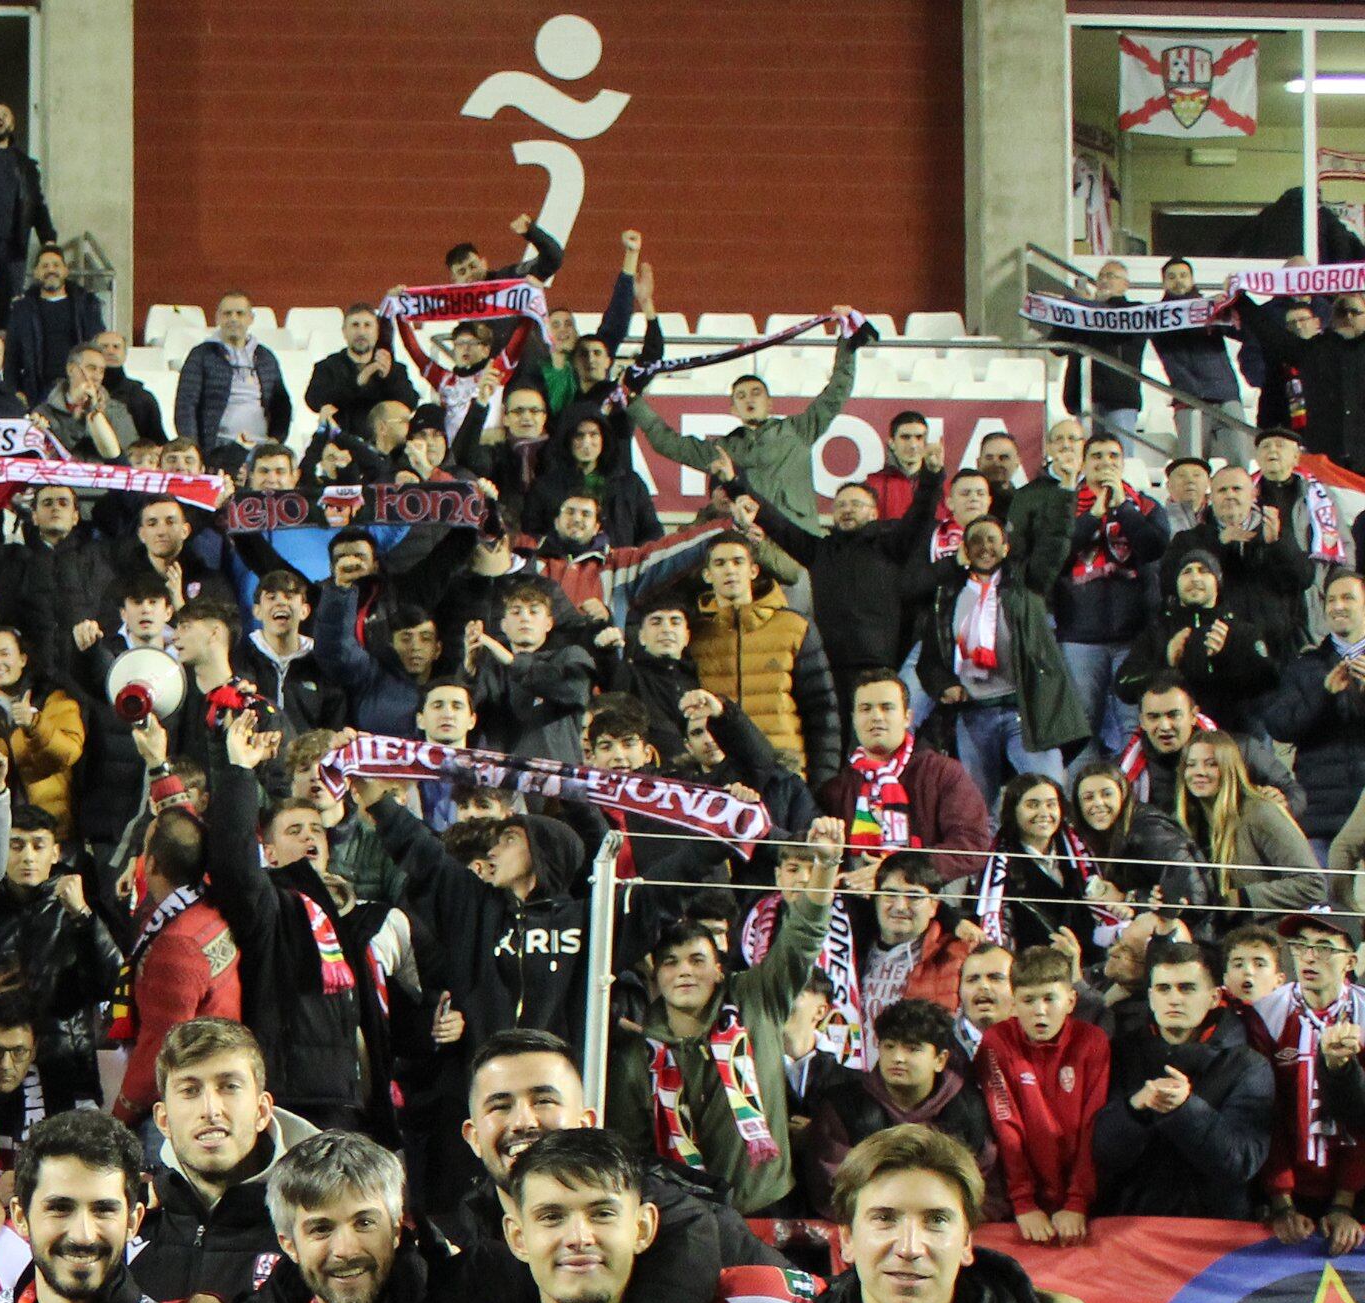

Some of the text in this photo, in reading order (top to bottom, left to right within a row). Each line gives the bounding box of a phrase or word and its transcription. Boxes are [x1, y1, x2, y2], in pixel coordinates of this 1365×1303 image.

[1246, 272, 1274, 293] UD
[1051, 304, 1183, 330] UD LOGROÑÉS
